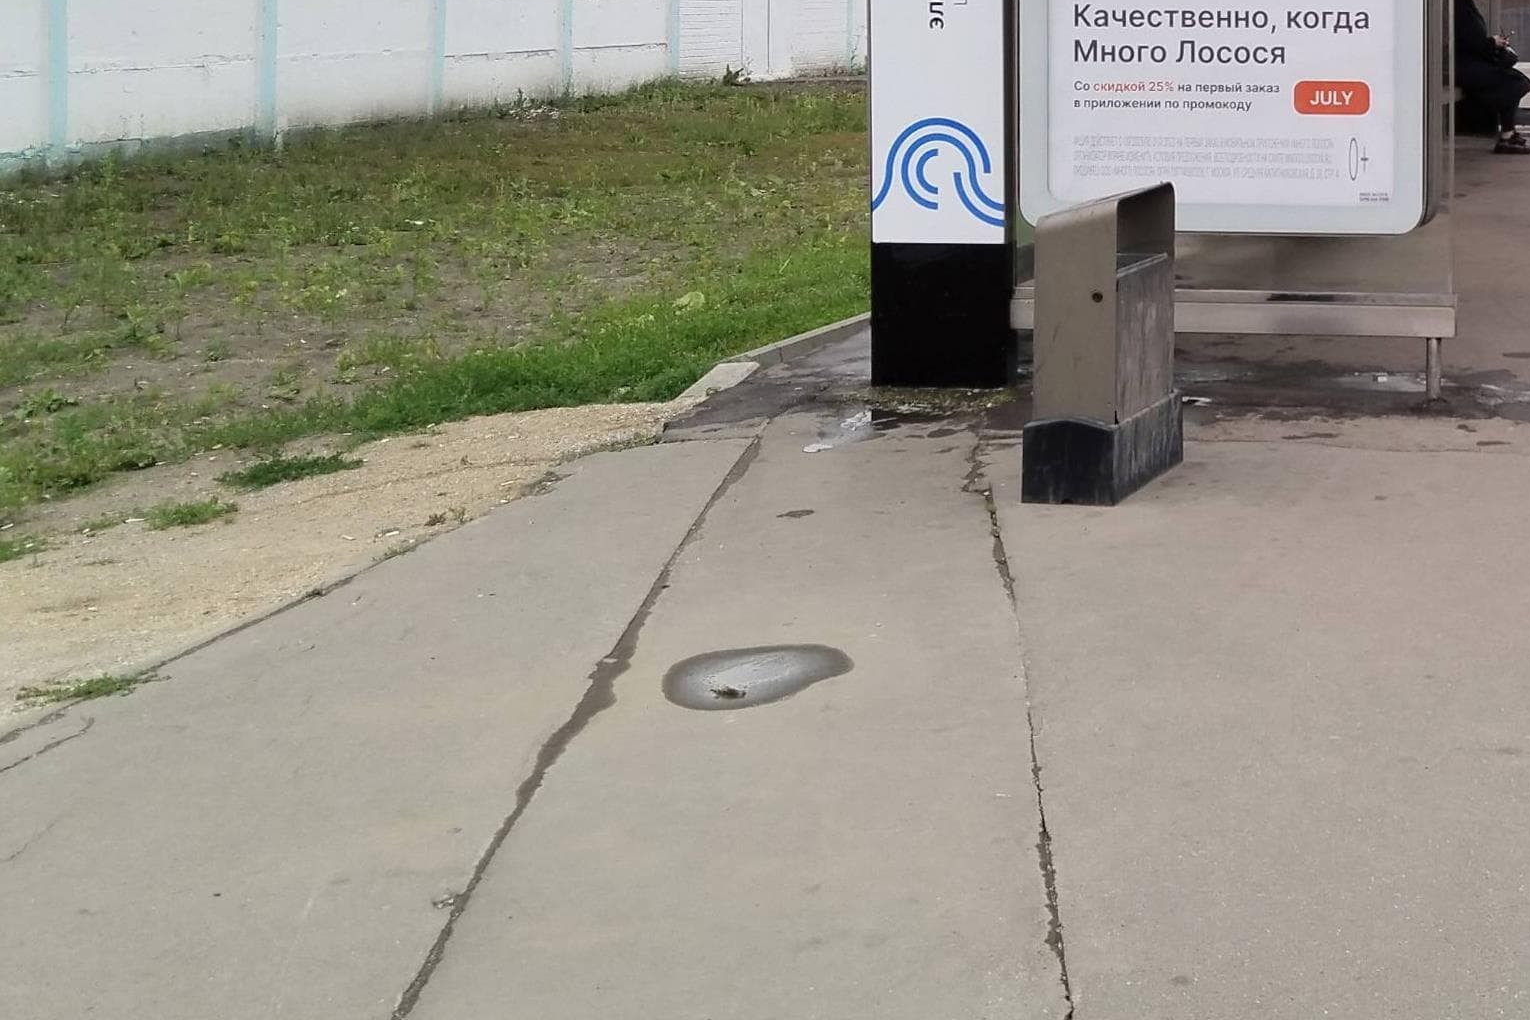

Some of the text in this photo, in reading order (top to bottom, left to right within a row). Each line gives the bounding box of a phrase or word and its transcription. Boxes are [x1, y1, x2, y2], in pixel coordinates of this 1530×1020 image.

[1073, 3, 1370, 34] Качественно, когда
[1073, 39, 1286, 65] Много Лосося
[1073, 80, 1280, 95] Со скидкой 25% на первый заказ
[1073, 98, 1253, 112] в приложении по промокоду
[1309, 90, 1354, 106] JULY
